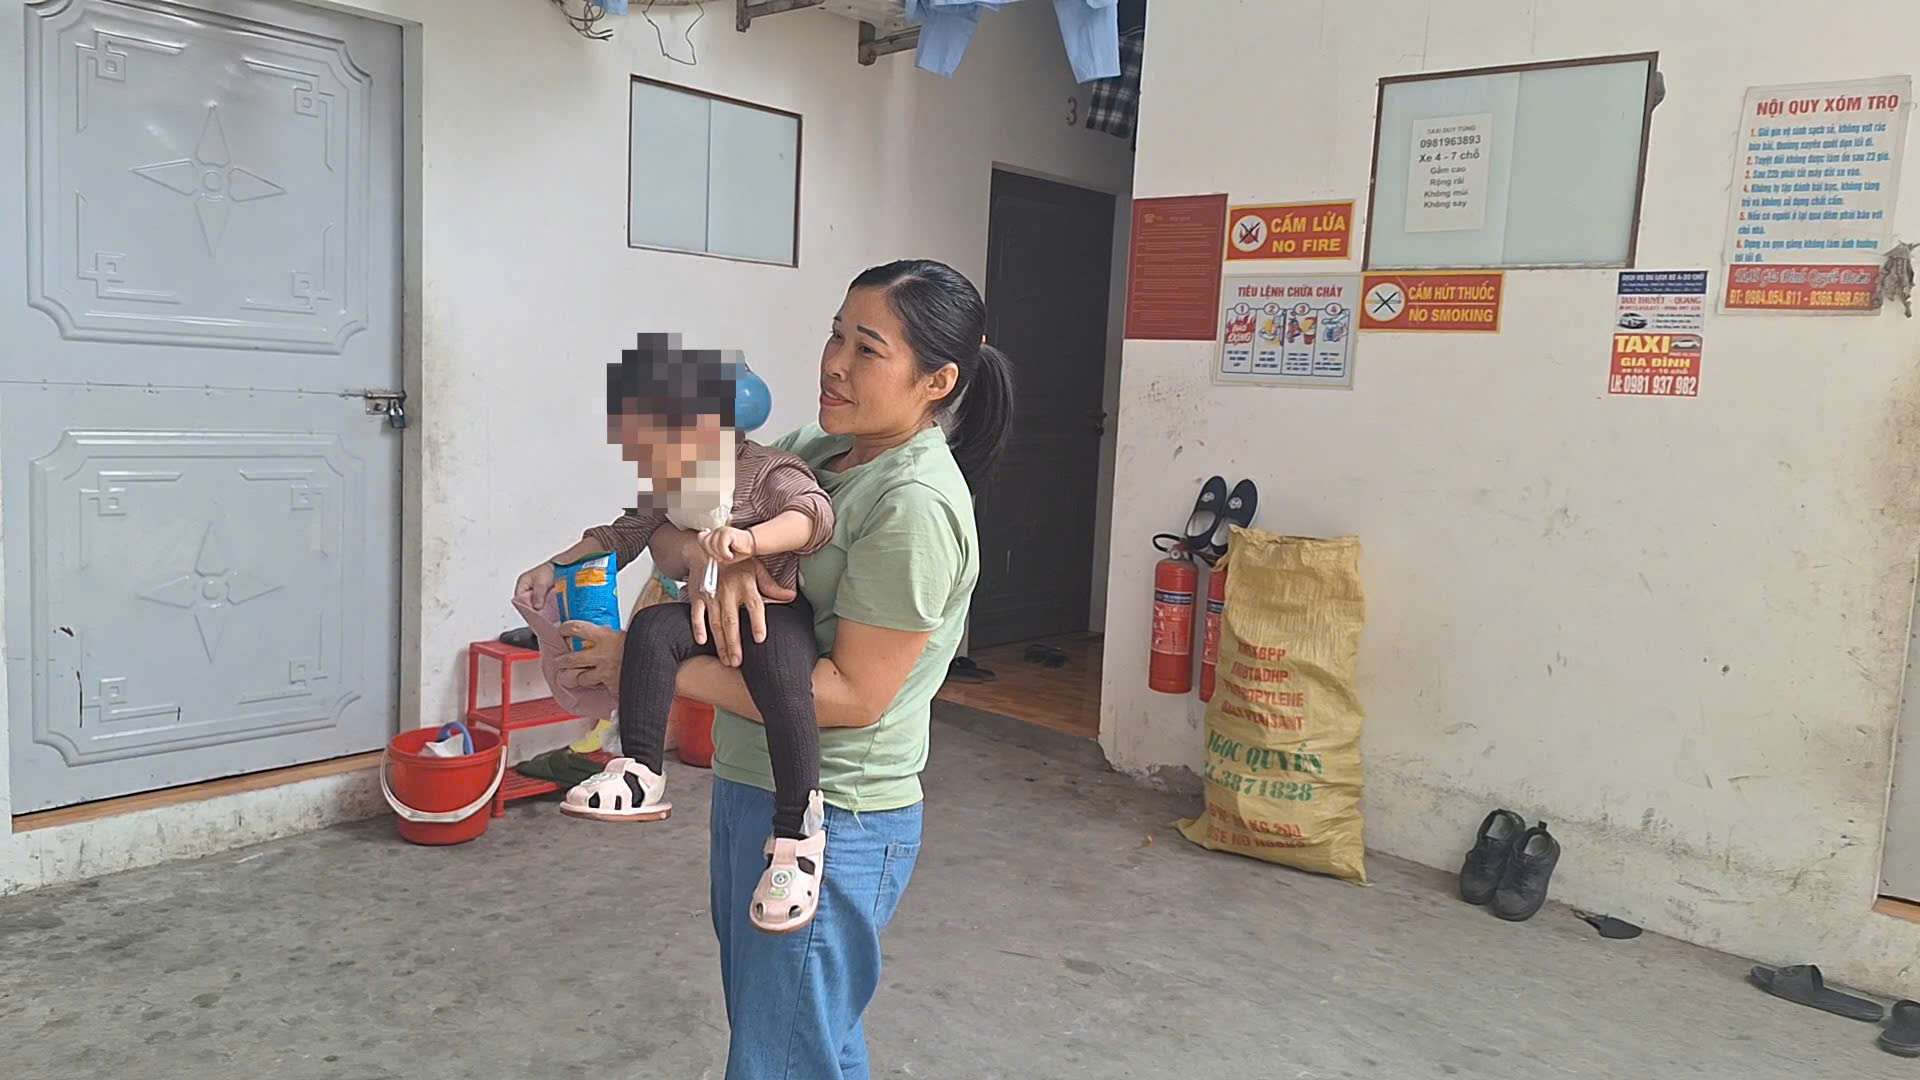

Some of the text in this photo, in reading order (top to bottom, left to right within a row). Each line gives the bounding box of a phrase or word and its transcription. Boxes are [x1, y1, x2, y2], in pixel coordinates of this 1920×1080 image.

[1066, 96, 1077, 126] 3
[1756, 94, 1899, 118] NỘI QUY XÓM TRỌ
[1420, 135, 1481, 148] 0981963893
[1418, 154, 1432, 163] Xe
[1435, 153, 1441, 161] 4
[1451, 151, 1457, 160] 7
[1460, 148, 1481, 160] chỗ
[1430, 165, 1449, 175] Gầm
[1430, 178, 1452, 187] Rộng
[1424, 190, 1451, 199] Không
[1424, 200, 1451, 209] Không
[1271, 211, 1346, 233] CẤM LỬA
[1272, 238, 1341, 253] NO FIRE
[1238, 284, 1343, 299] TIÊU LỆNH CHỮA CHÁY
[1408, 280, 1495, 300] CẤM HÚT THUỐC
[1408, 309, 1494, 322] NO SMOKING
[1614, 335, 1671, 353] TAXI
[1620, 355, 1692, 368] GIA ĐÌNH
[1623, 375, 1649, 393] 0981
[1652, 376, 1673, 394] 937
[1675, 376, 1697, 395] 982
